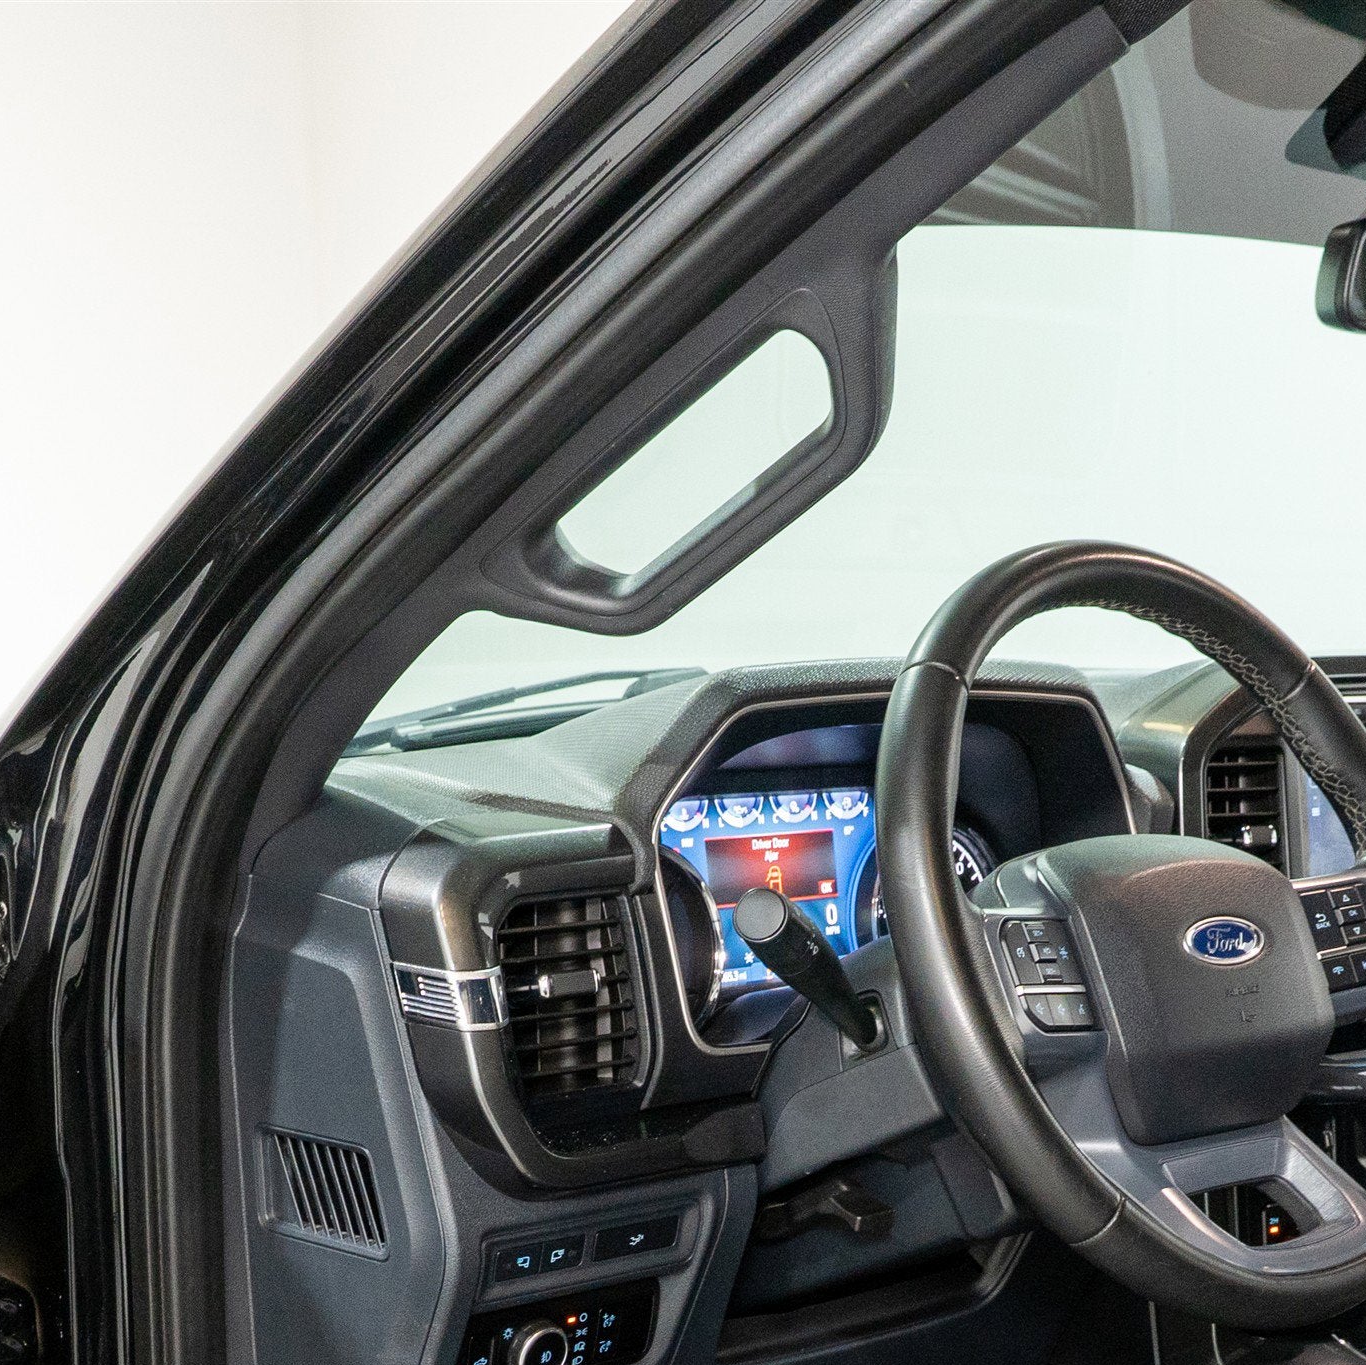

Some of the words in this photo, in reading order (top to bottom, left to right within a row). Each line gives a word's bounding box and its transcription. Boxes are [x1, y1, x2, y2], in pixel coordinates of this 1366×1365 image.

[751, 838, 772, 850] Driver
[773, 837, 790, 848] Door
[820, 882, 833, 893] OK
[825, 903, 838, 926] 0
[1315, 922, 1331, 930] BACK
[1206, 927, 1257, 954] Ford
